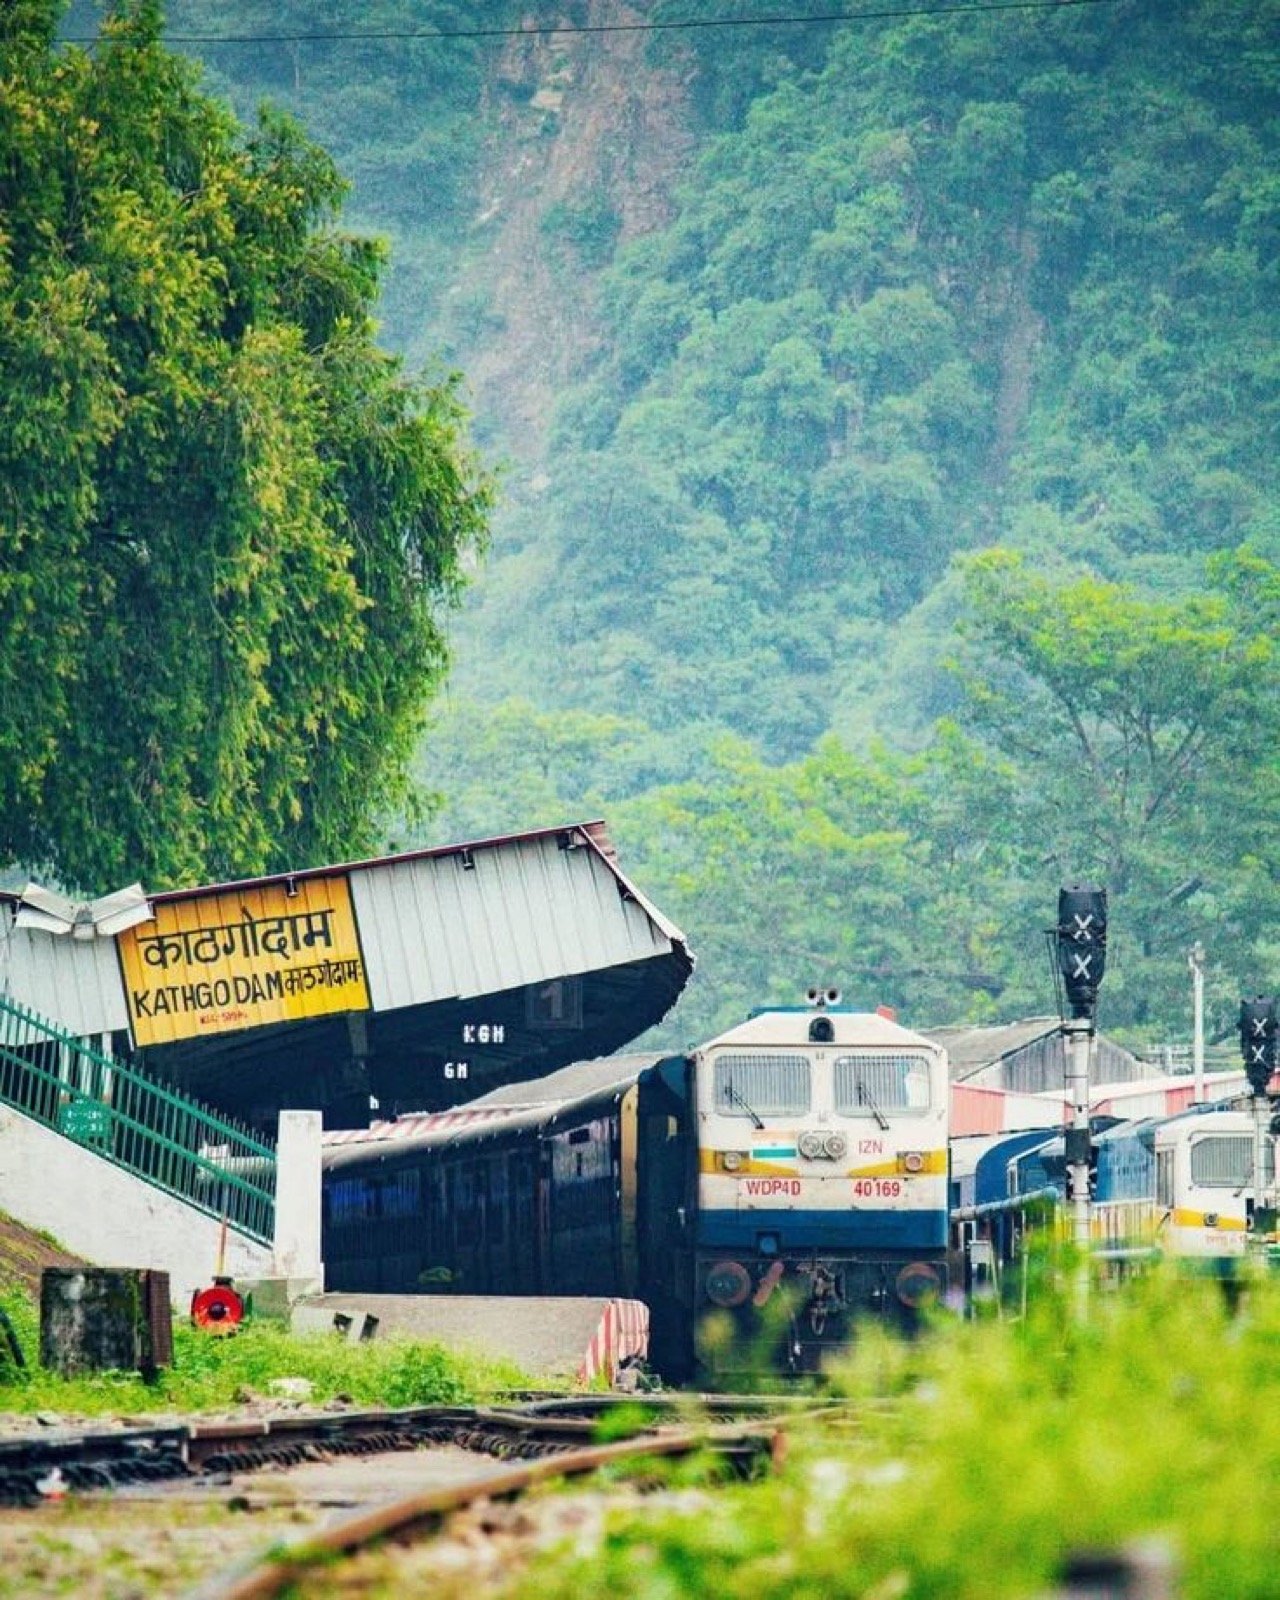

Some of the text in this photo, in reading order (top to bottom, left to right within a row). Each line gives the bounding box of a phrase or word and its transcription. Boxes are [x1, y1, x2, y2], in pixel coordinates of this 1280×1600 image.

[137, 905, 335, 969] काठगोदाम
[134, 970, 285, 1018] KATHGODAM
[540, 981, 563, 1018] 1
[858, 1139, 883, 1154] IZN
[746, 1179, 801, 1196] WDP4D
[853, 1180, 901, 1197] 40169
